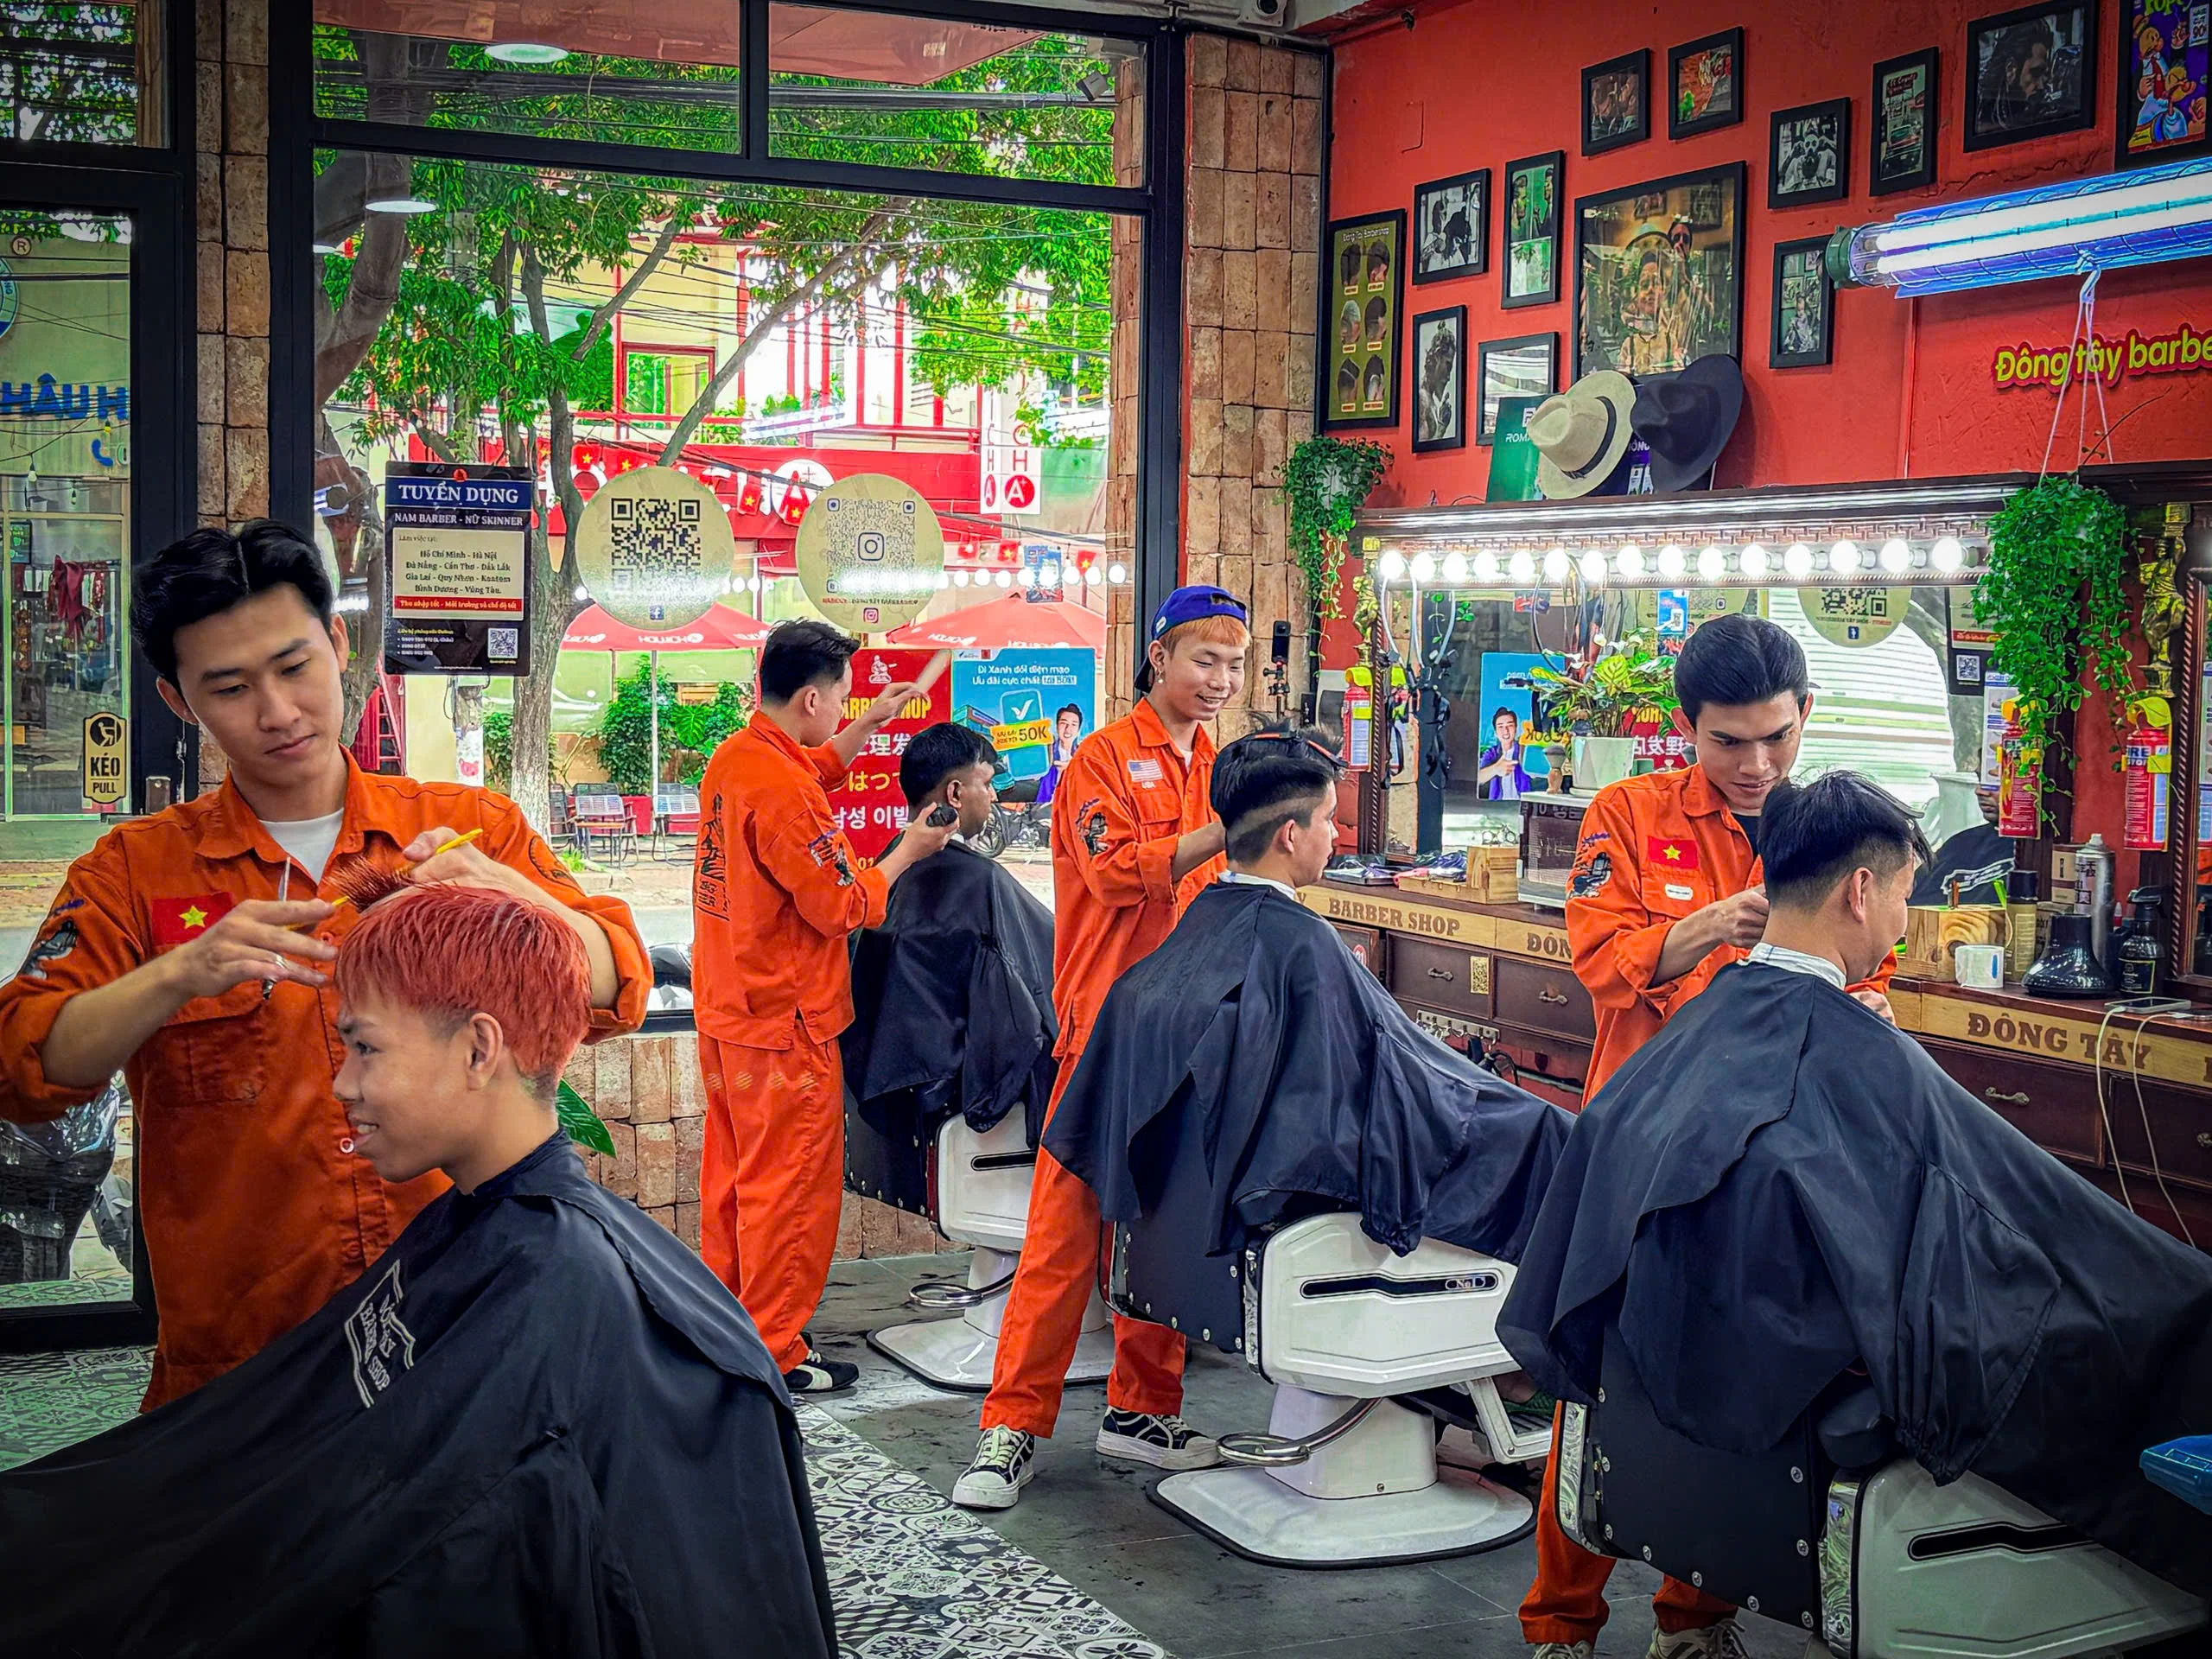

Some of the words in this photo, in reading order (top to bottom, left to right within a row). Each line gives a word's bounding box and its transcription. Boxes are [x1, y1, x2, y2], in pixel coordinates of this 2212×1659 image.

[1994, 346, 2069, 386] Đông
[2075, 338, 2123, 381] tây
[397, 480, 462, 502] TUYỂN
[466, 487, 519, 505] DỤNG
[394, 512, 417, 524] NAM
[419, 513, 457, 524] BARBER
[481, 515, 524, 526] SKINNER
[988, 664, 1012, 675] Xanh
[1019, 724, 1049, 741] 50K
[90, 752, 121, 777] KÉO
[92, 782, 118, 793] PULL
[1328, 897, 1403, 928] BARBER
[1408, 912, 1461, 937] SHOP
[1527, 931, 1572, 957] ĐÔN
[1967, 1012, 2069, 1053] ĐÔNG
[2080, 1032, 2152, 1071] TÂY
